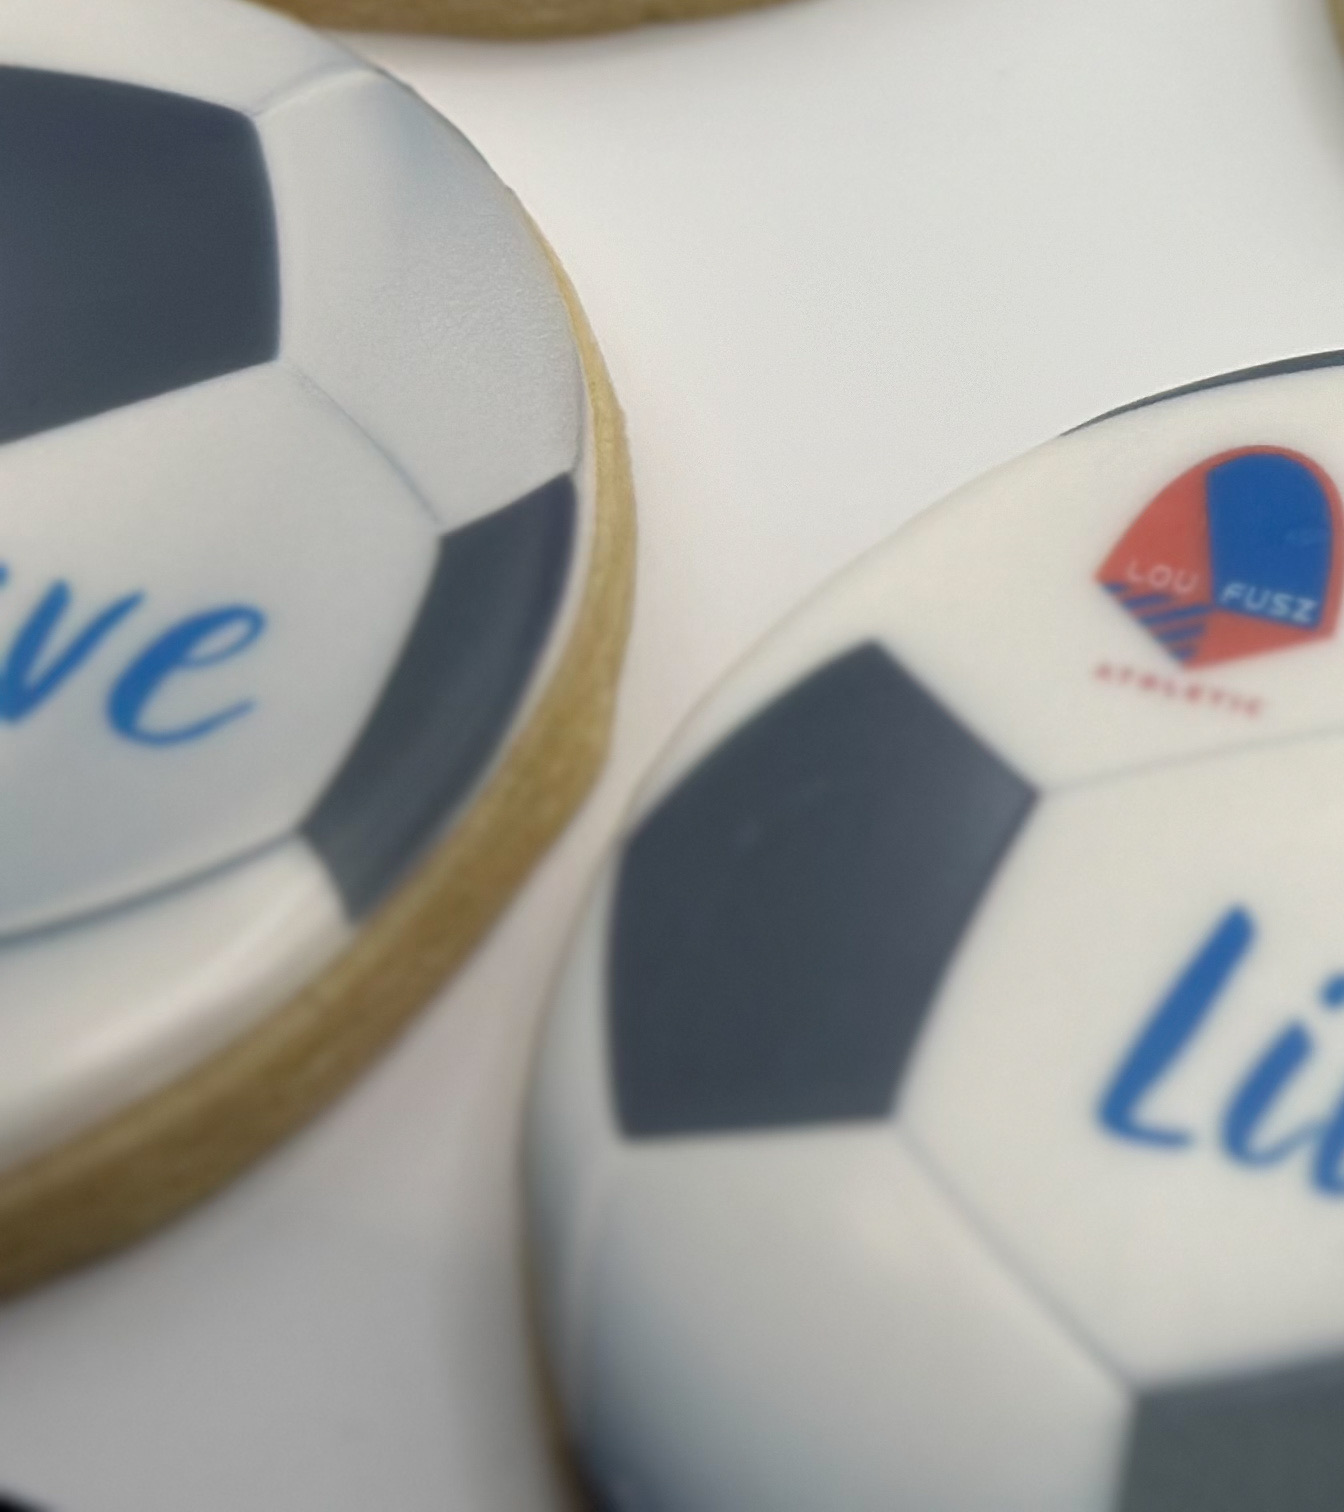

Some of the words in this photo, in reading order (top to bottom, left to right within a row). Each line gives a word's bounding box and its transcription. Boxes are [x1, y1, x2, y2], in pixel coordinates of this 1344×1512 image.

[0, 560, 265, 748] ve
[1124, 558, 1200, 596] LOU
[1220, 582, 1319, 625] FUSZ
